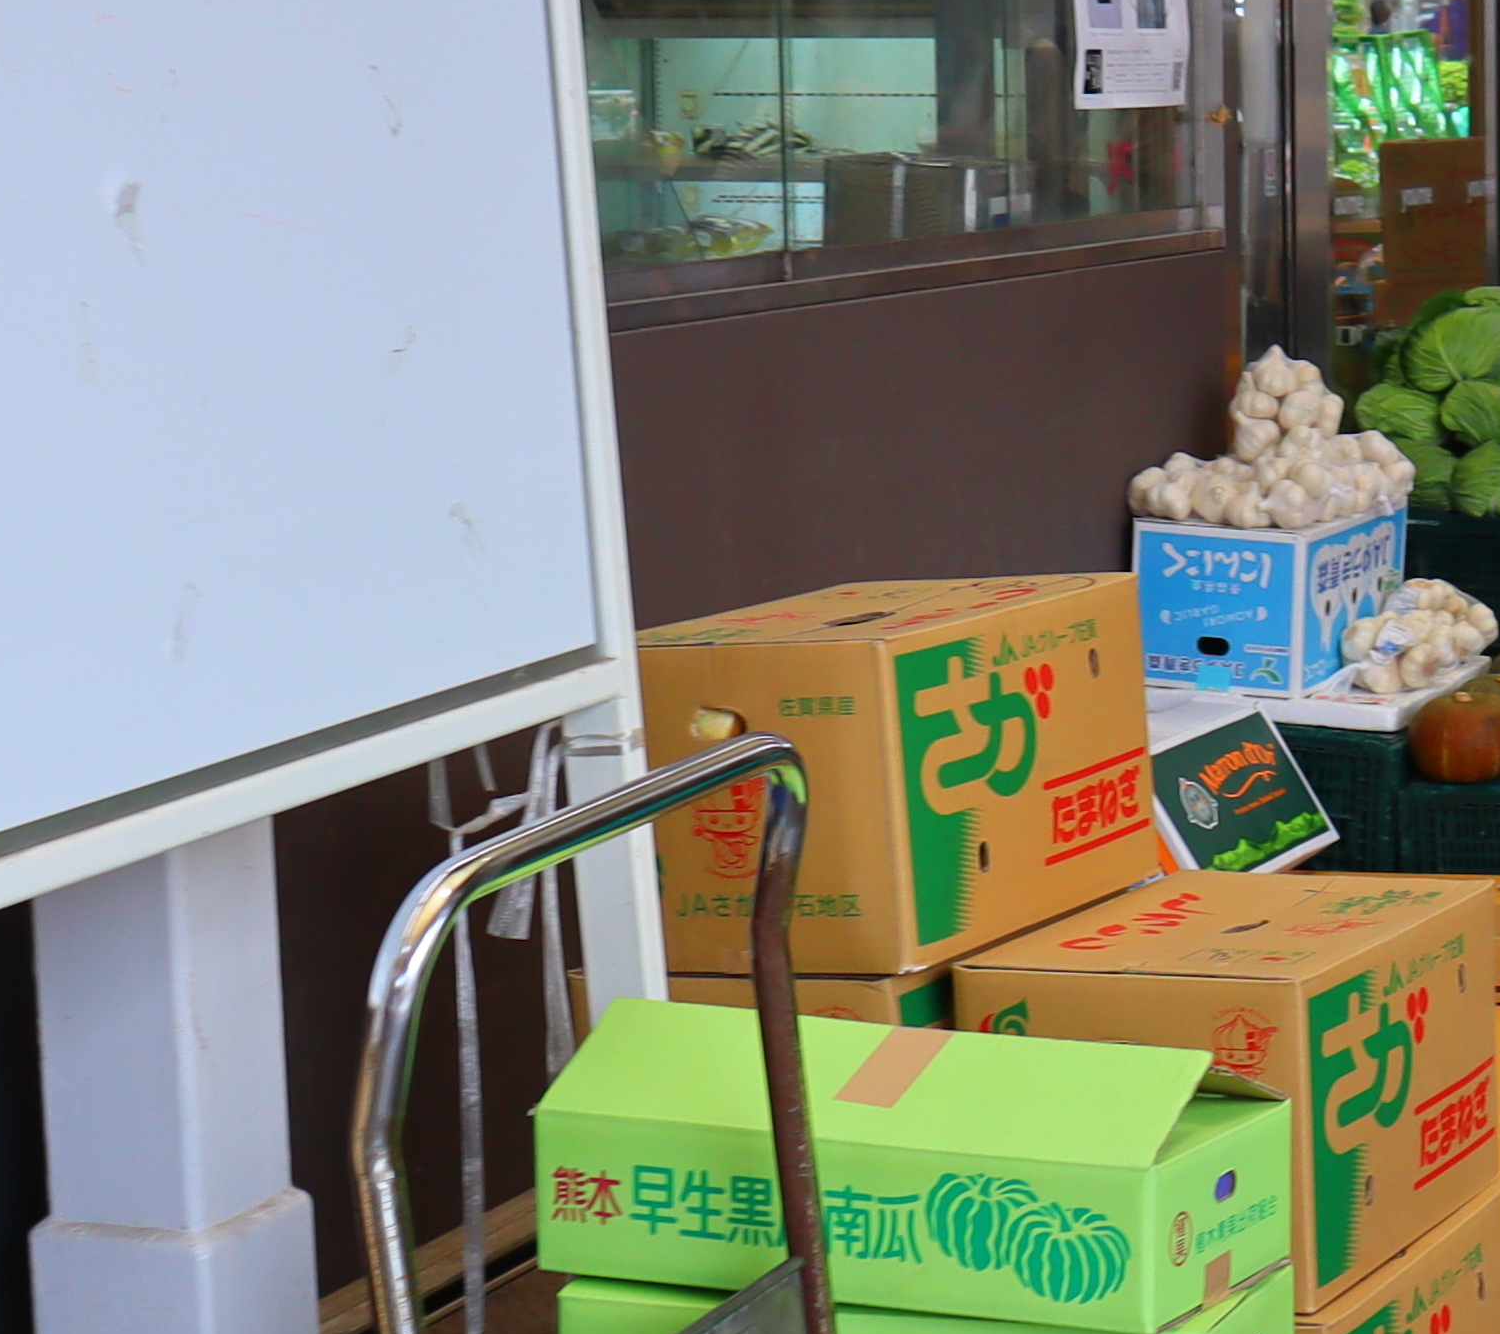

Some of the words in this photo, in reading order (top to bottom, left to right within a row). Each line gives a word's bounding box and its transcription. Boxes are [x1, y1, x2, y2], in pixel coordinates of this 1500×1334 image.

[1161, 542, 1272, 592] にんにく
[778, 693, 857, 718] 佐賀県産
[912, 655, 1056, 817] さが
[1050, 765, 1141, 845] たまねぎ
[790, 893, 861, 919] 石地区
[1320, 986, 1430, 1158] さが
[1420, 1077, 1492, 1169] たまねぎ
[551, 1166, 623, 1225] 熊本
[631, 1164, 924, 1264] 早生黒南瓜
